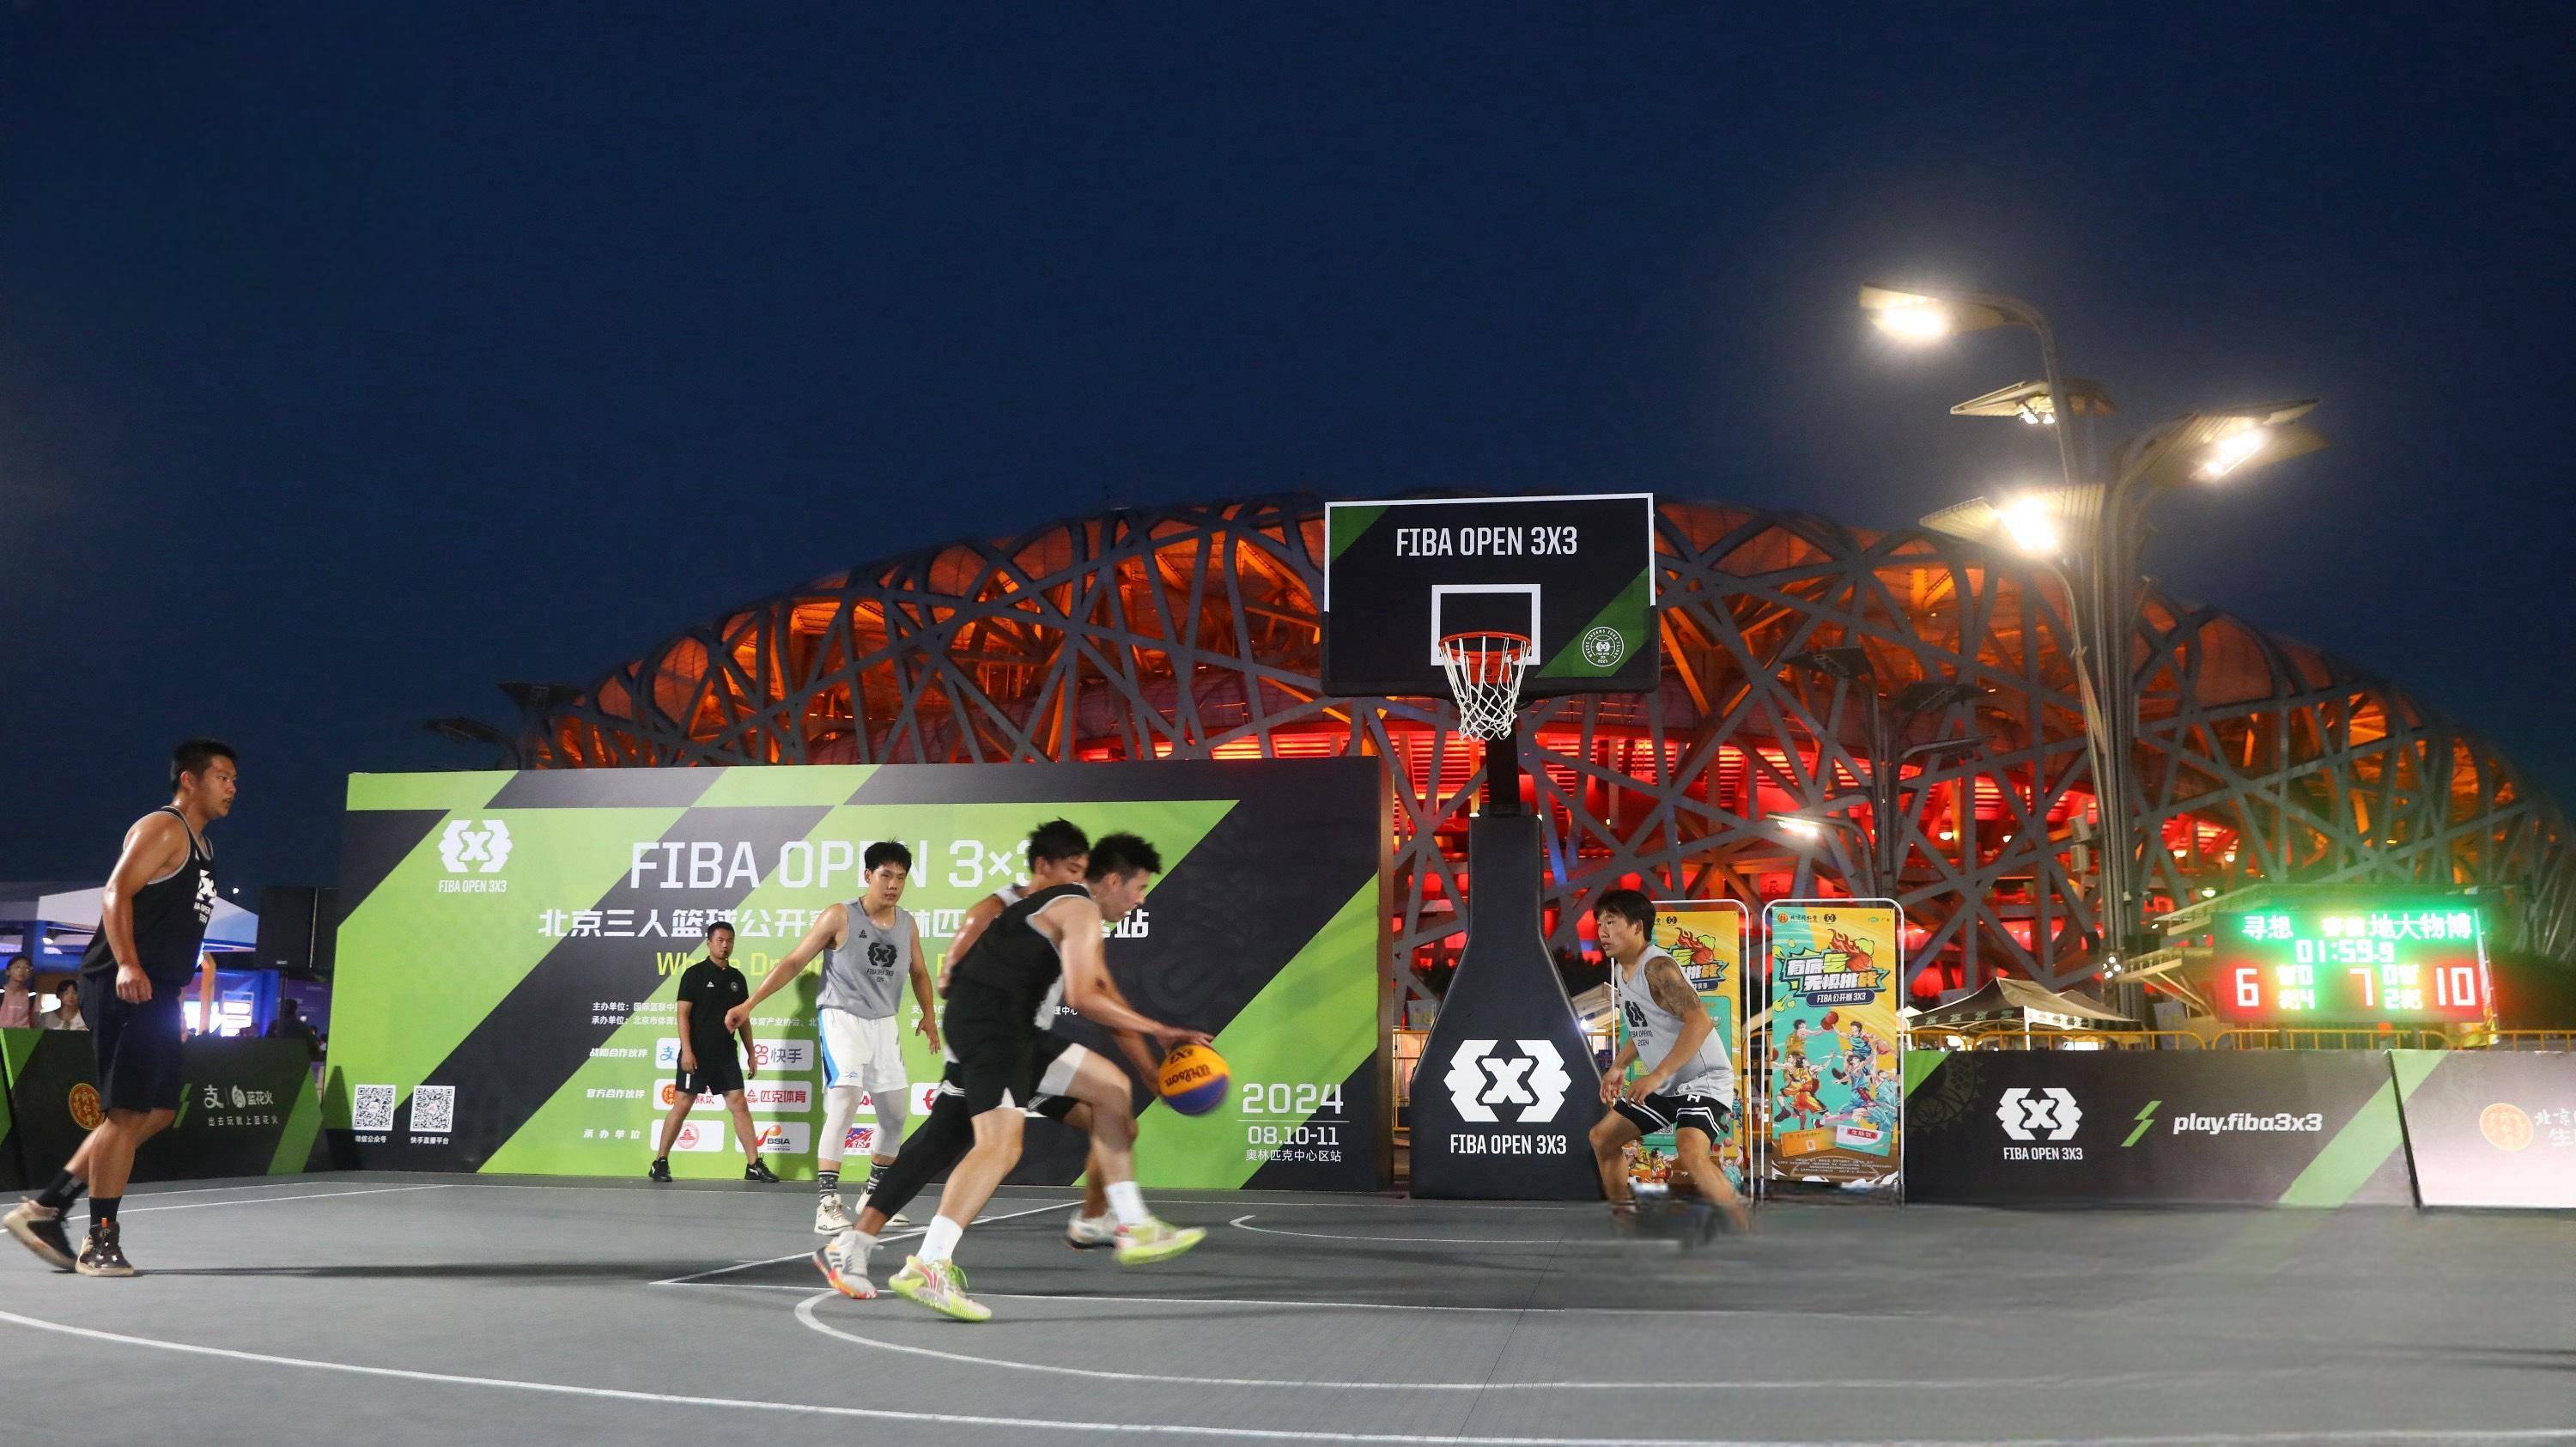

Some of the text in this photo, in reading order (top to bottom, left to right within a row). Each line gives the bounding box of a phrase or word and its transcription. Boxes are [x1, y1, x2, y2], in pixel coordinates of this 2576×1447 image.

[1396, 526, 1577, 556] FIBA OPEN 3X3
[630, 842, 760, 889] FIBA
[779, 841, 927, 888] OPN
[439, 879, 507, 893] FIBA OPEN 3X3
[2236, 968, 2259, 1007] 6
[2349, 968, 2374, 1006] 7
[2435, 967, 2476, 1006] 10
[1817, 994, 1832, 1003] FIBA
[771, 1048, 803, 1064] 快手
[1164, 1064, 1212, 1087] Wilson
[761, 1090, 807, 1103] 匹克体育
[1242, 1083, 1344, 1114] 2024
[2172, 1113, 2323, 1134] play.fiba3x3
[1248, 1126, 1340, 1146] 08.10-11
[1450, 1134, 1567, 1155] FIBA OPEN 3X3
[1246, 1149, 1342, 1163] 奥林匹克中心区站
[2003, 1147, 2083, 1160] FIBA OPEN 3X3
